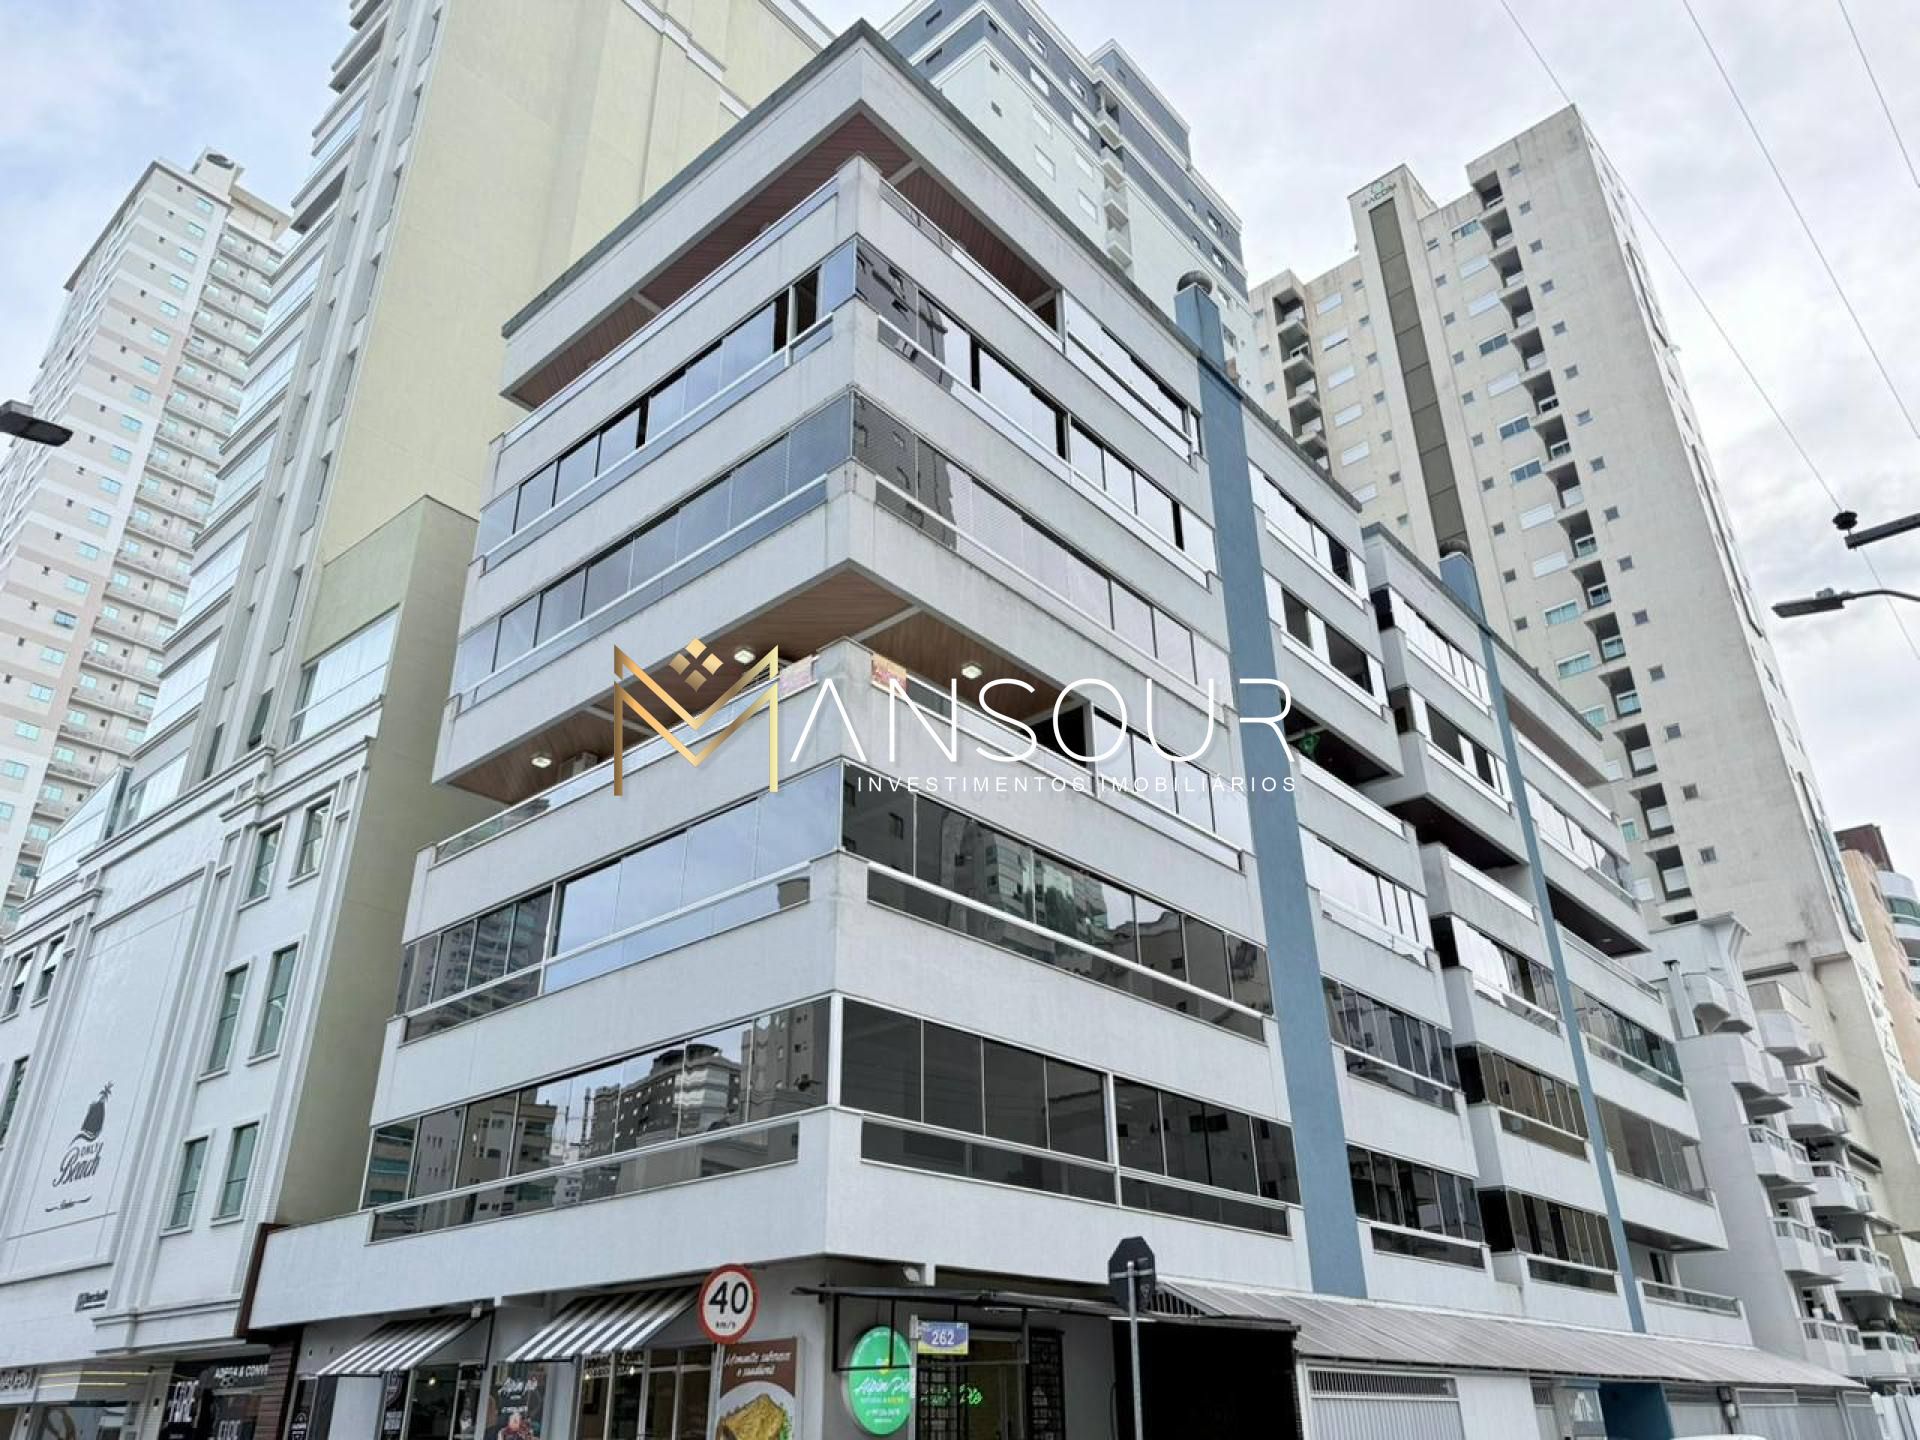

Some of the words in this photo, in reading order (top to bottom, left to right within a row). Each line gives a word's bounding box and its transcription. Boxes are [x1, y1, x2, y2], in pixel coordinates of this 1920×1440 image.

[52, 1146, 101, 1187] Beach
[709, 1280, 749, 1315] 40
[715, 1321, 737, 1330] km/h
[932, 1330, 956, 1345] 262
